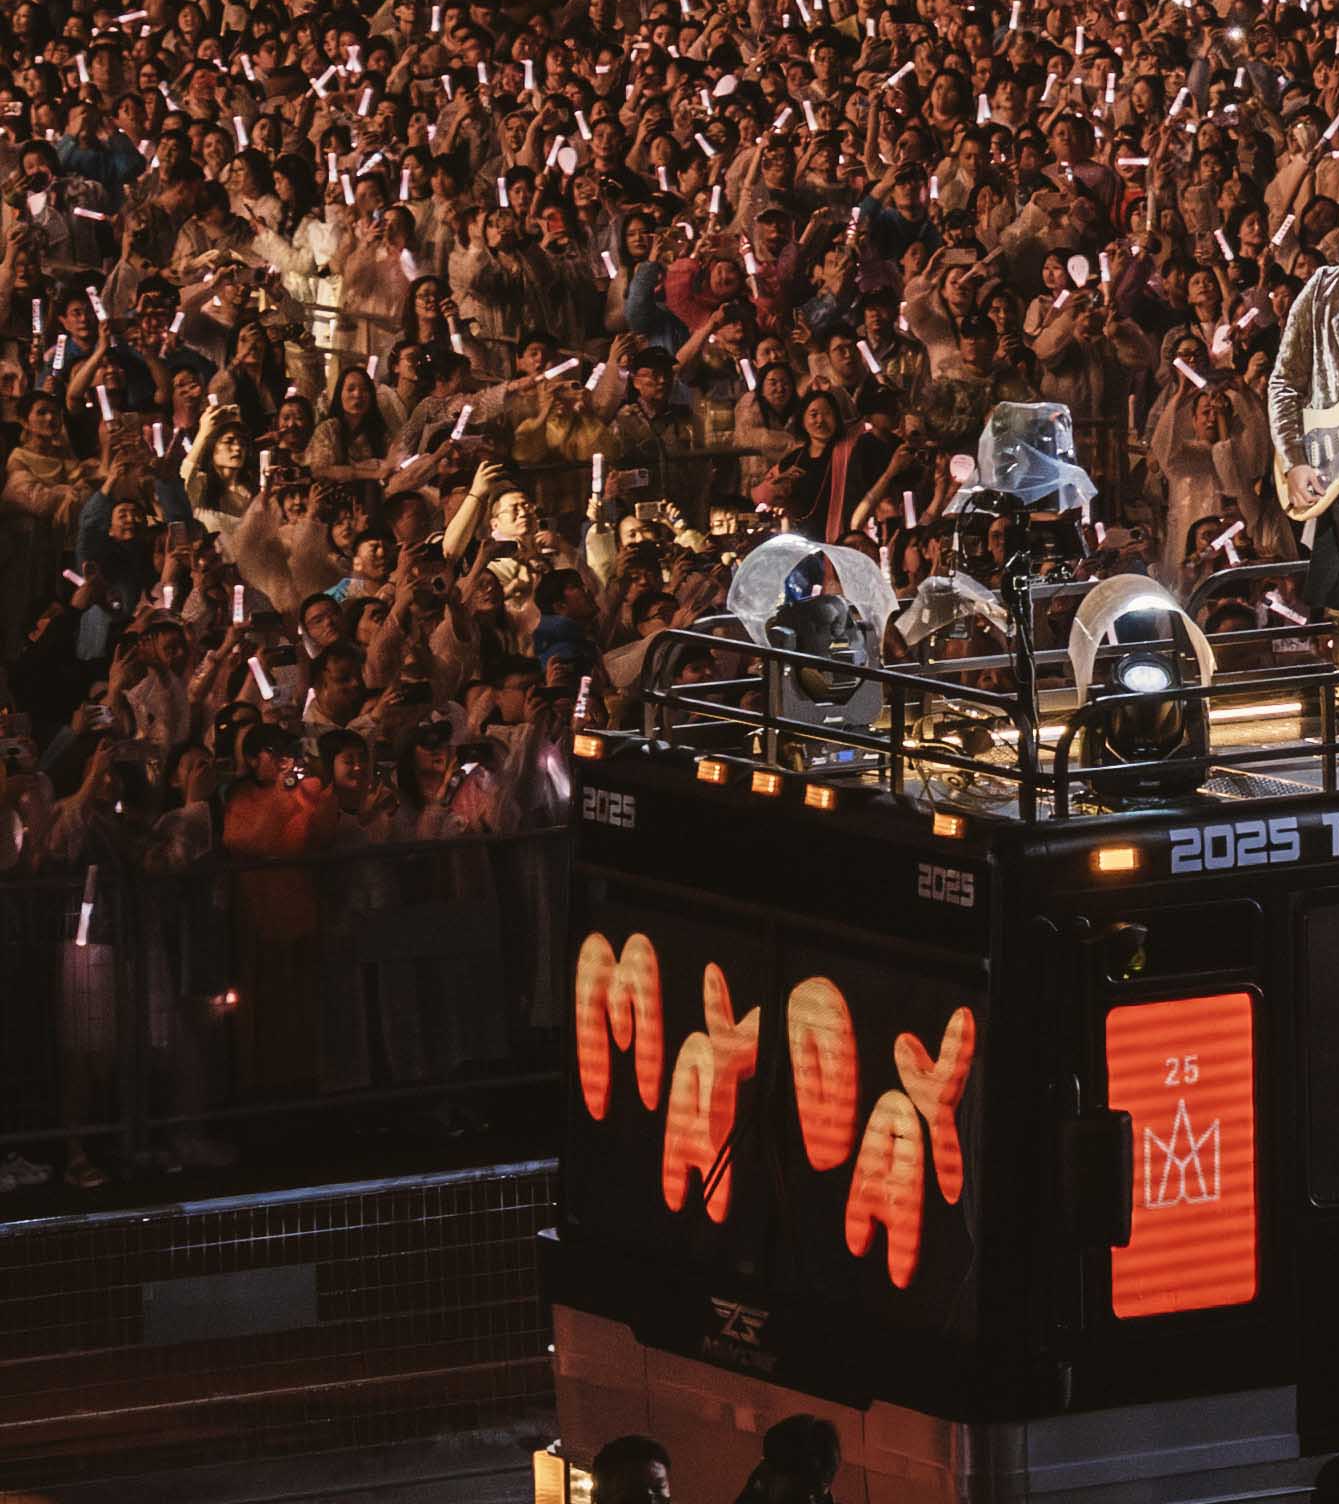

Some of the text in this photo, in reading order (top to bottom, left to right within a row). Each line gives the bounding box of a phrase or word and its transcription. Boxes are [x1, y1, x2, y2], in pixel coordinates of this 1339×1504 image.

[583, 786, 636, 829] 2025
[1170, 829, 1300, 873] 2025
[917, 863, 976, 907] 2025
[1164, 1055, 1200, 1086] 25
